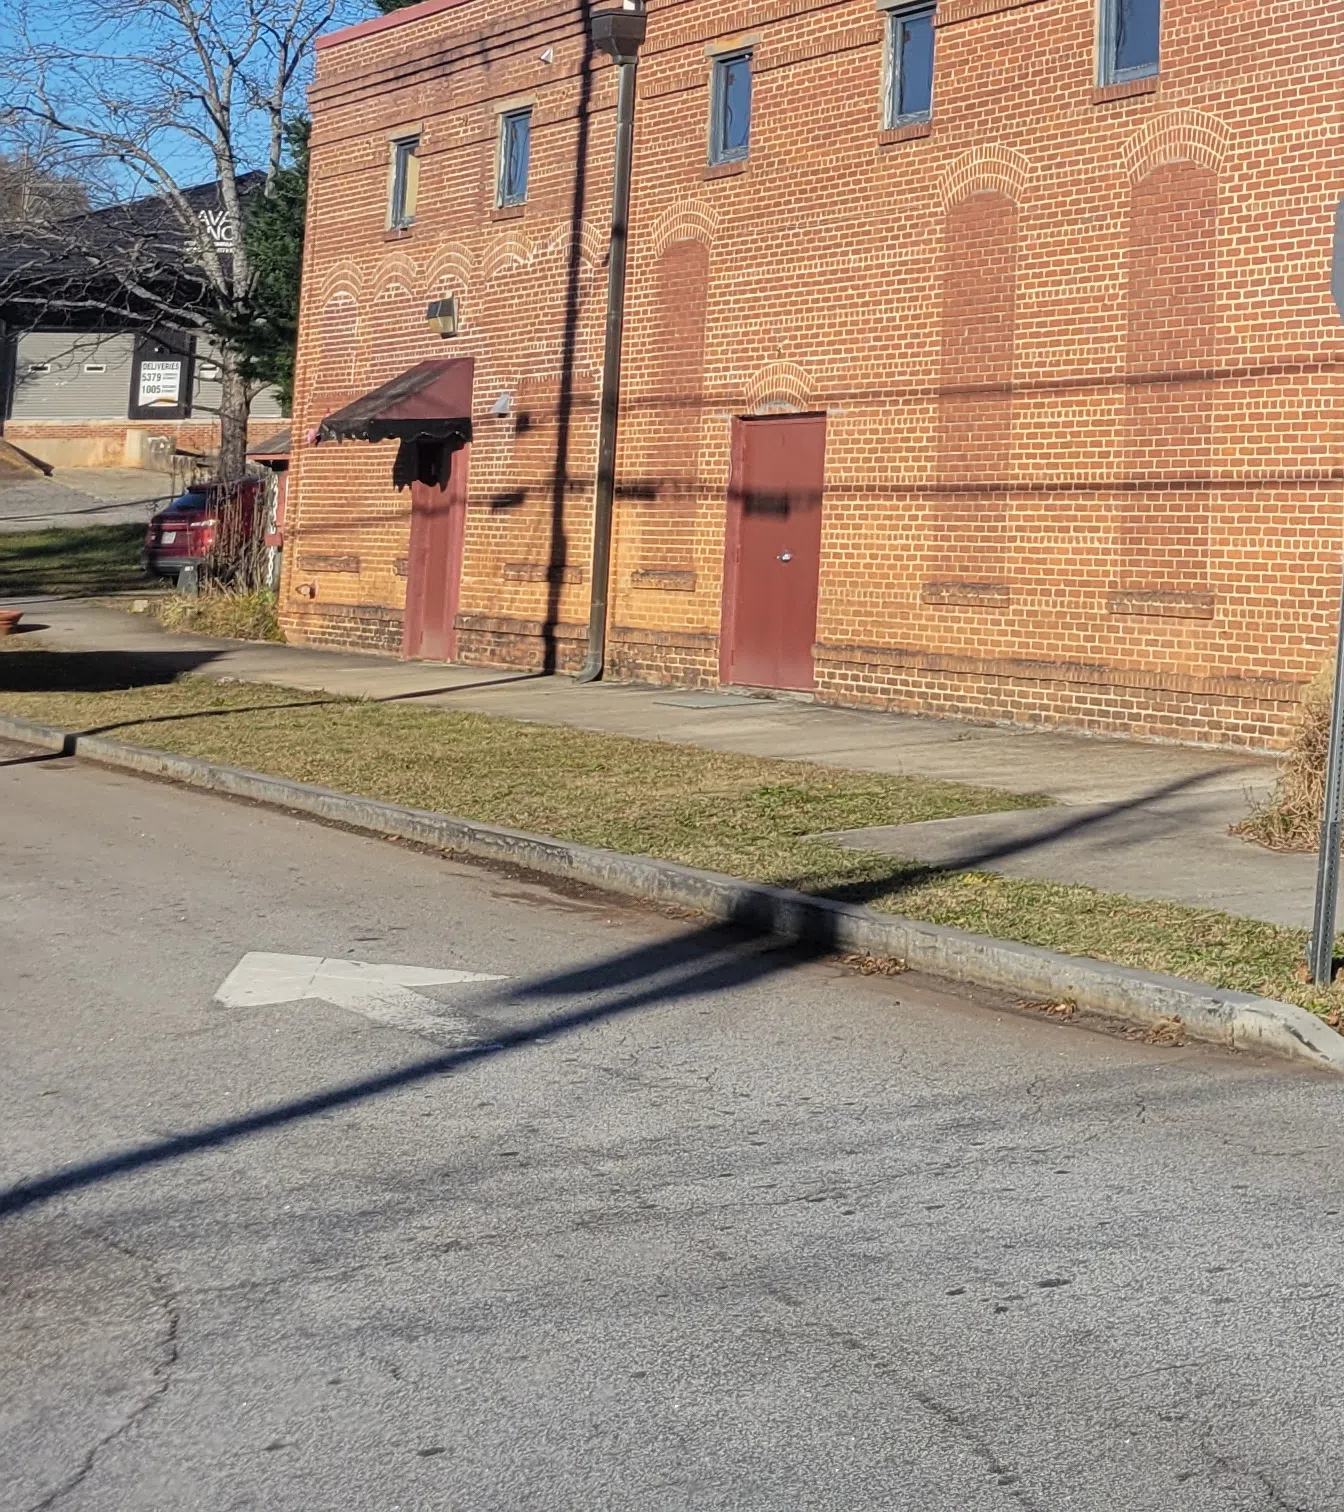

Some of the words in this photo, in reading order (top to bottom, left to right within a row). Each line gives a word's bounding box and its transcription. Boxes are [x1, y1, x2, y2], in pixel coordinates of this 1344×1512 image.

[143, 362, 180, 371] DELIVERIES
[142, 372, 162, 382] 5379
[142, 384, 161, 394] 1005
